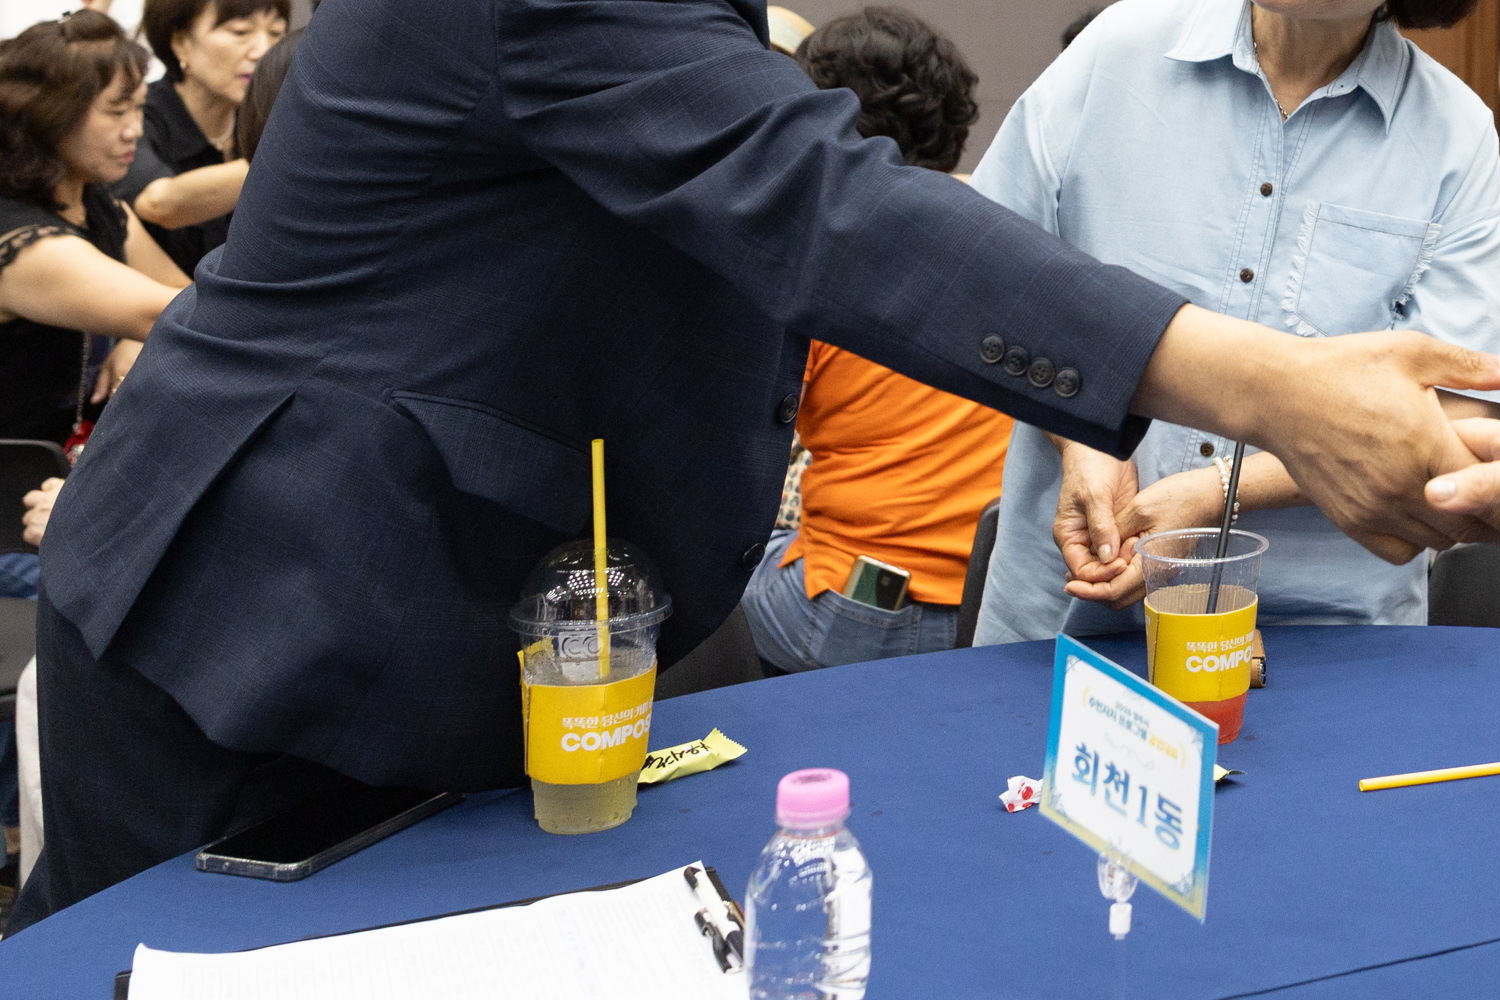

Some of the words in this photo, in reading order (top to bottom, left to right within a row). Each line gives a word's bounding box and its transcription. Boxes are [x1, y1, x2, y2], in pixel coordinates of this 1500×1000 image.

[1186, 641, 1218, 653] 똑똑한
[1221, 635, 1245, 652] 당신의
[1186, 643, 1254, 673] COMPO
[562, 716, 599, 729] 똑똑한
[602, 707, 634, 728] 당신의
[1071, 742, 1183, 850] 회천1동
